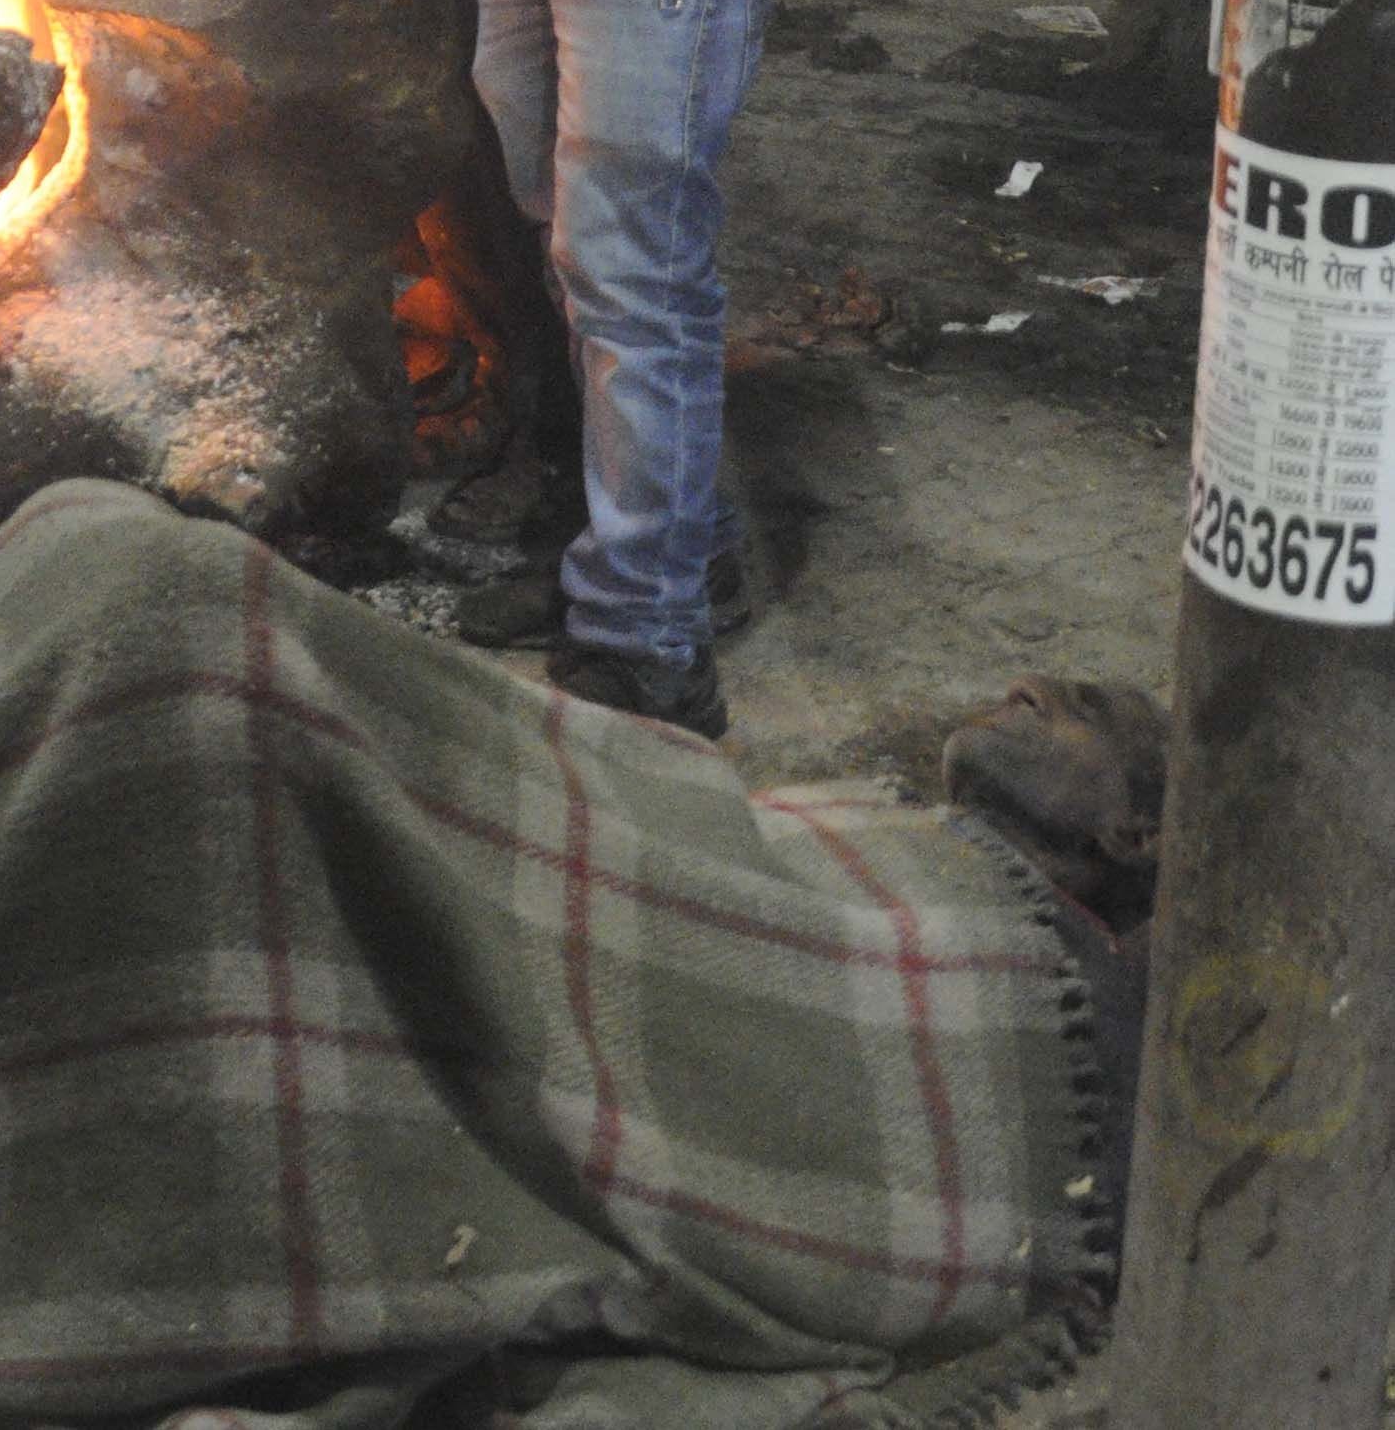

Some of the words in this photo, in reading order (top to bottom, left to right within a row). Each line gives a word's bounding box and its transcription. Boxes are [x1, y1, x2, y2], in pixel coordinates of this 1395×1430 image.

[1244, 240, 1309, 285] कम्पनी
[1321, 252, 1368, 293] रोल
[1191, 474, 1378, 604] 2263675
